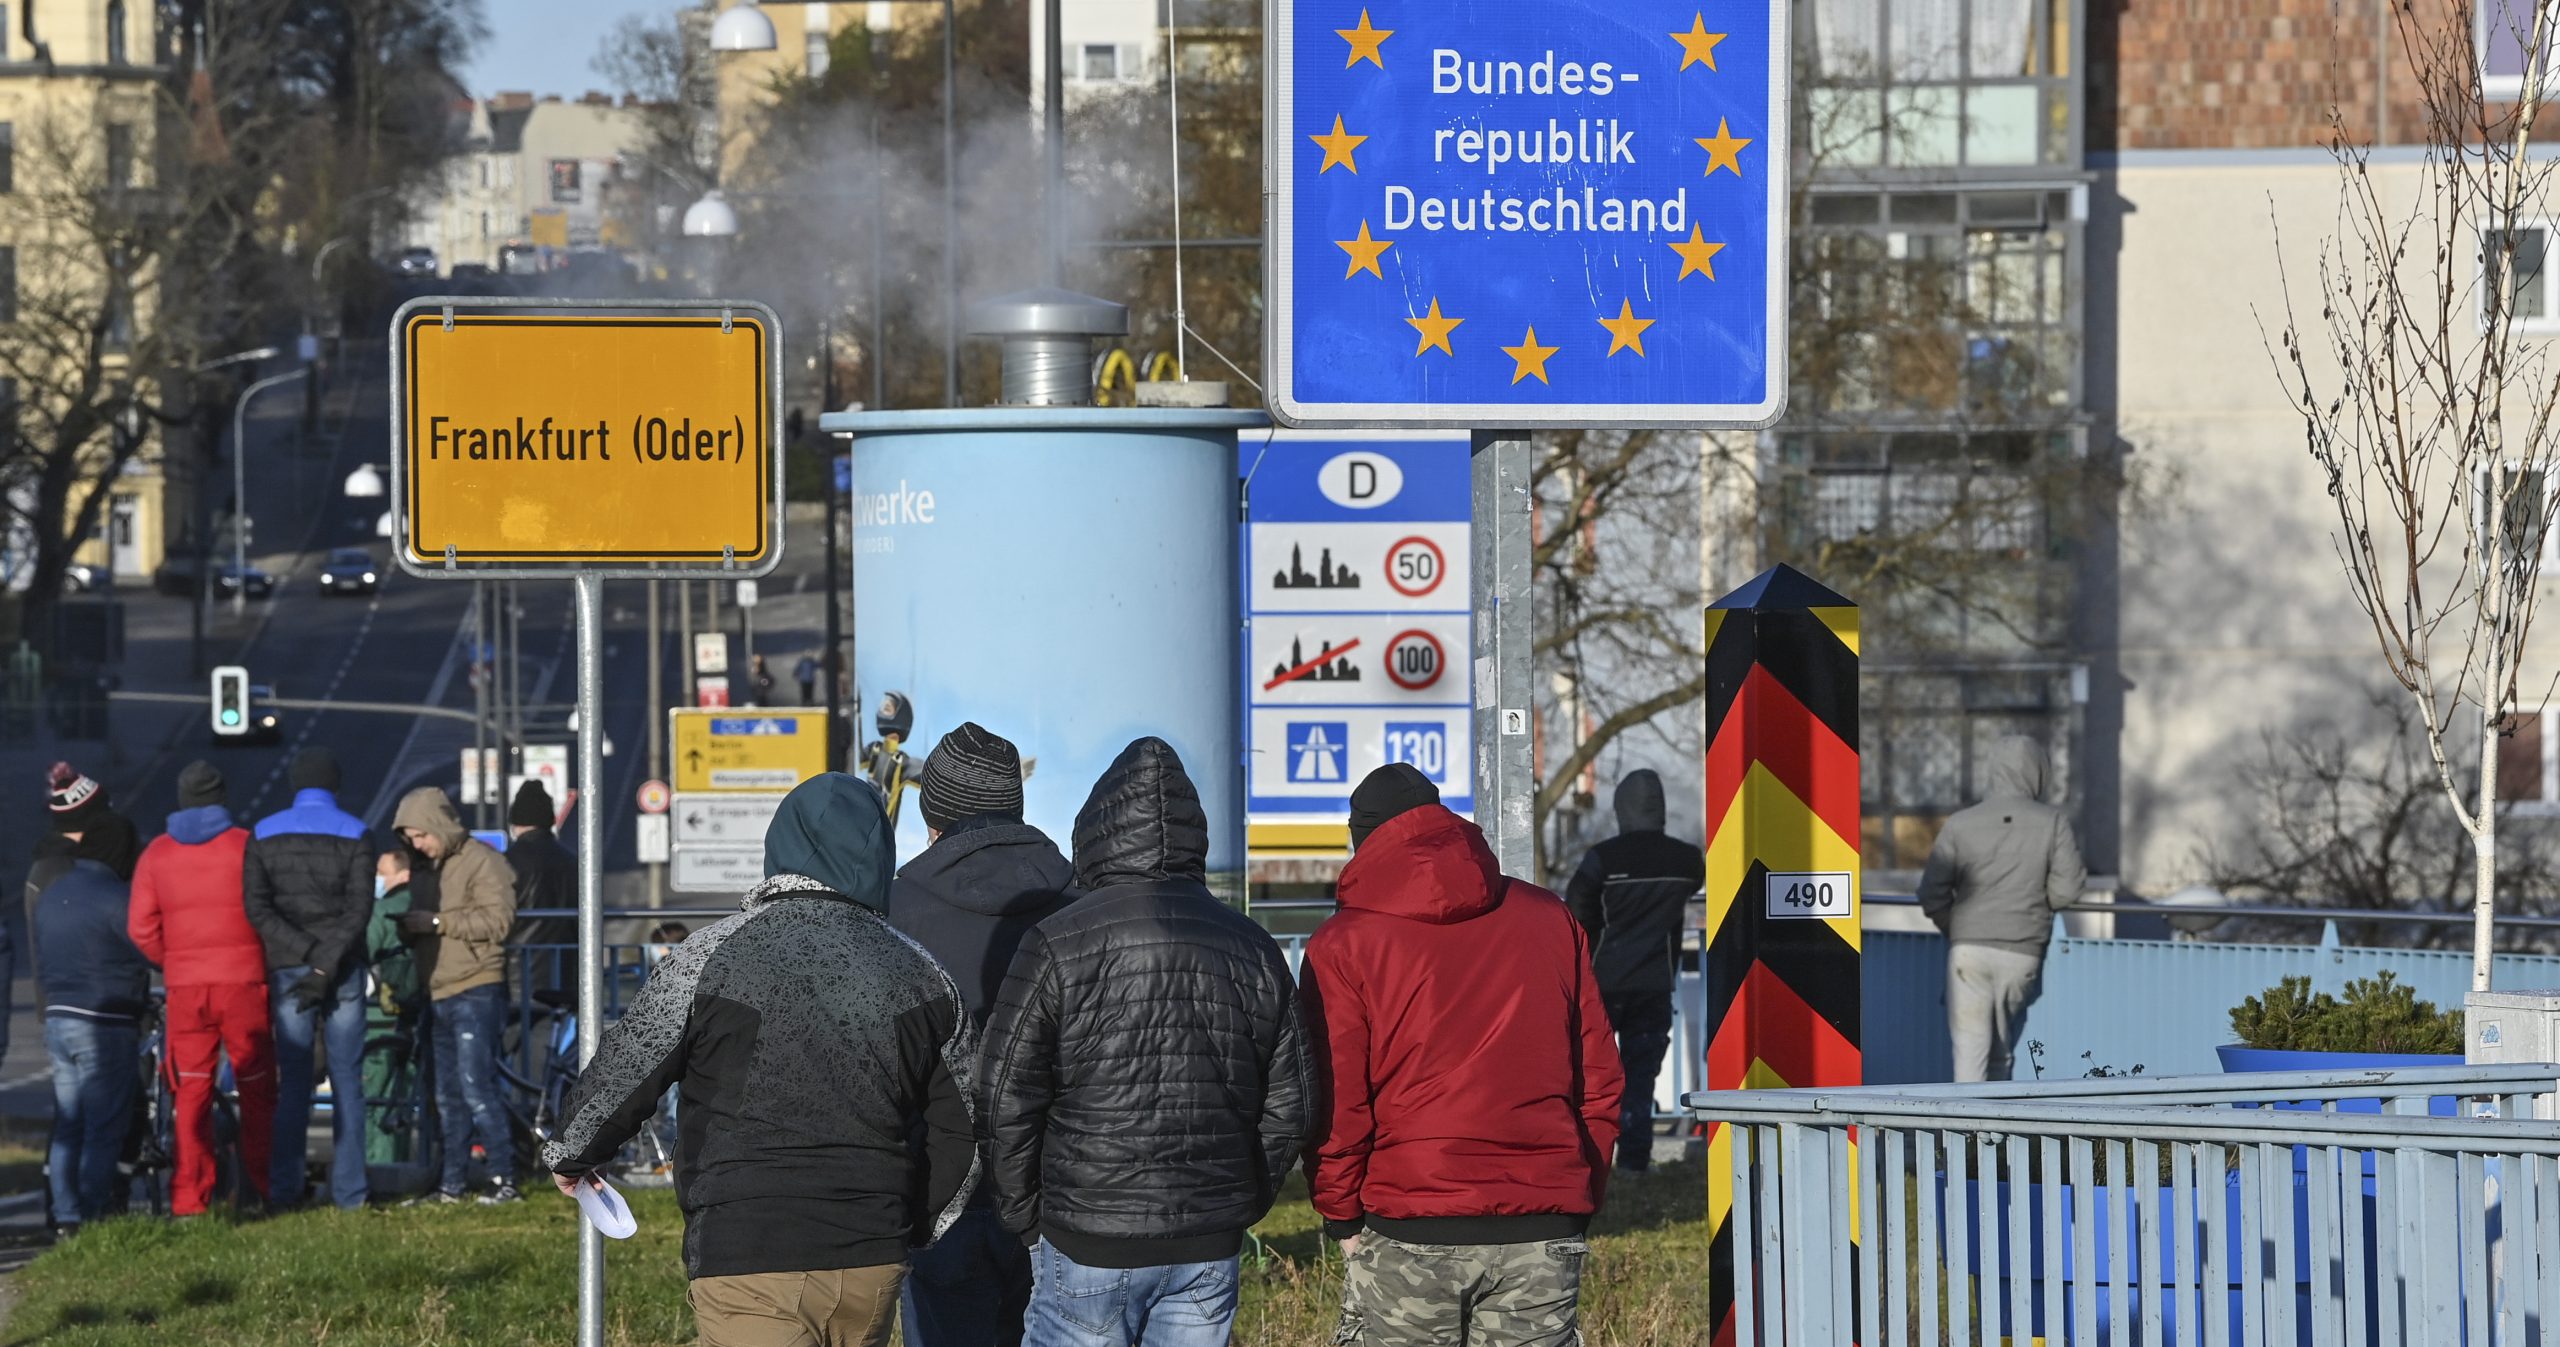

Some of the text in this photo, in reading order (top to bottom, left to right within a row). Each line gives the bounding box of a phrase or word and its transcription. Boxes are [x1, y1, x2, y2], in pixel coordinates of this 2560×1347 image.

[1433, 49, 1640, 94] Bundes-
[1434, 118, 1636, 174] republik
[1384, 185, 1686, 232] Deutschland
[430, 414, 744, 464] Frankfurt (Oder)
[1349, 460, 1377, 499] D
[1399, 552, 1433, 581] 50
[1396, 645, 1434, 676] 100
[1386, 730, 1443, 775] 130
[1784, 882, 1833, 908] 490
